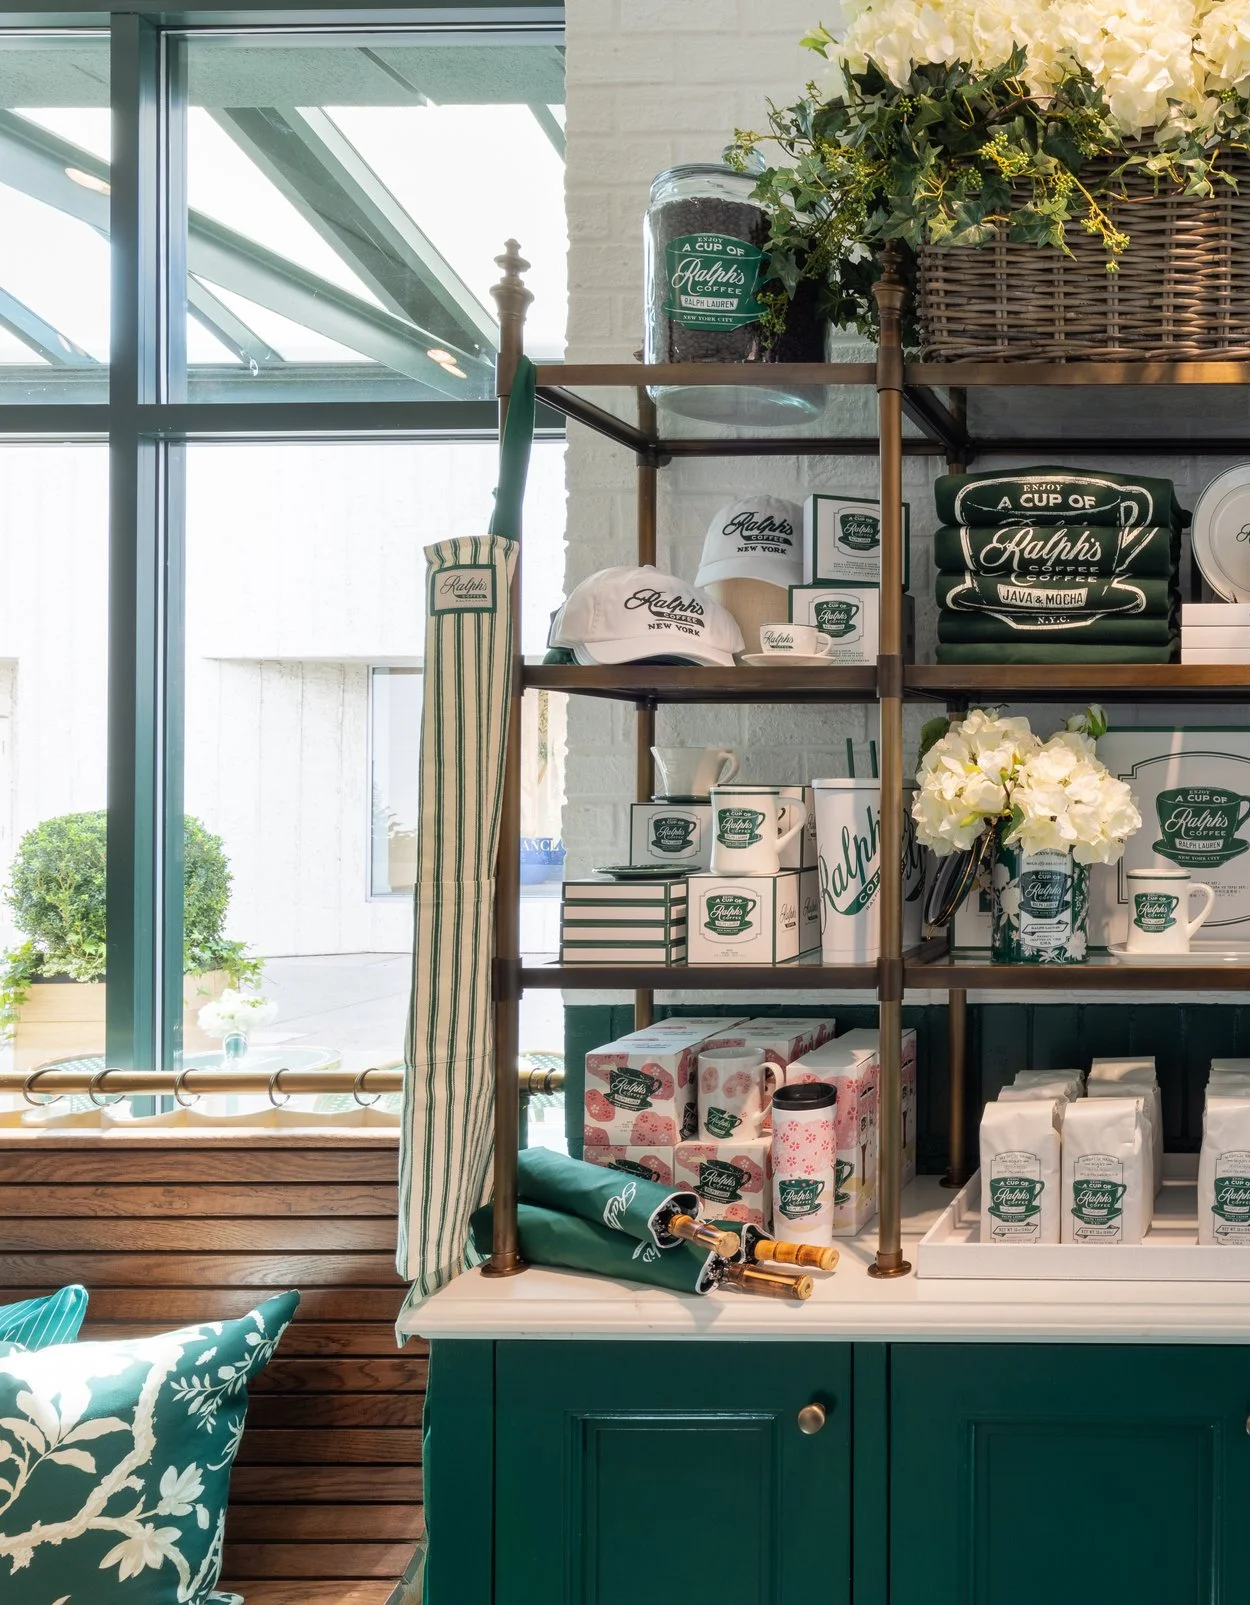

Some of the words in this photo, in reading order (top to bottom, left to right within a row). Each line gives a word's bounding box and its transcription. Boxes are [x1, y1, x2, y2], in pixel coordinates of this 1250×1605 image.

[682, 244, 692, 253] A
[695, 242, 723, 251] CUP
[727, 245, 745, 256] OF
[671, 258, 745, 295] Ralph's
[696, 285, 742, 295] COFFEE
[684, 297, 705, 307] RALPH
[707, 299, 735, 309] LAUREN
[1023, 484, 1064, 492] ENJOY
[996, 497, 1012, 510] A
[1019, 493, 1062, 508] CUP
[1068, 494, 1096, 510] OF
[722, 511, 794, 538] Ralph's
[751, 535, 785, 543] COFFEE
[761, 546, 787, 555] YORK
[979, 526, 1102, 572] Ralph's
[1029, 565, 1099, 573] COFFEE
[440, 575, 487, 595] Ralph's
[1026, 574, 1097, 583] COFFEE
[624, 589, 704, 617] Ralph's
[1002, 589, 1033, 604] JAVA
[1035, 596, 1044, 604] &
[1045, 592, 1083, 605] MOCHA
[663, 612, 698, 623] COFFEE
[818, 610, 847, 624] Ralph's
[1037, 616, 1070, 625] N.Y.C.
[676, 625, 700, 637] YORK
[763, 630, 794, 646] Ralph's
[721, 818, 752, 833] Ralph's
[1165, 807, 1228, 839] Ralph's
[657, 826, 684, 840] Ralph's
[1025, 882, 1061, 901] Ralph's
[710, 905, 742, 920] Ralph's
[1138, 903, 1167, 918] Ralph's
[611, 1078, 646, 1095] Ralph's
[701, 1170, 735, 1188] Ralph's
[782, 1190, 812, 1204] Ralph's
[994, 1188, 1029, 1206] Ralph's
[1077, 1190, 1111, 1208] Ralph's
